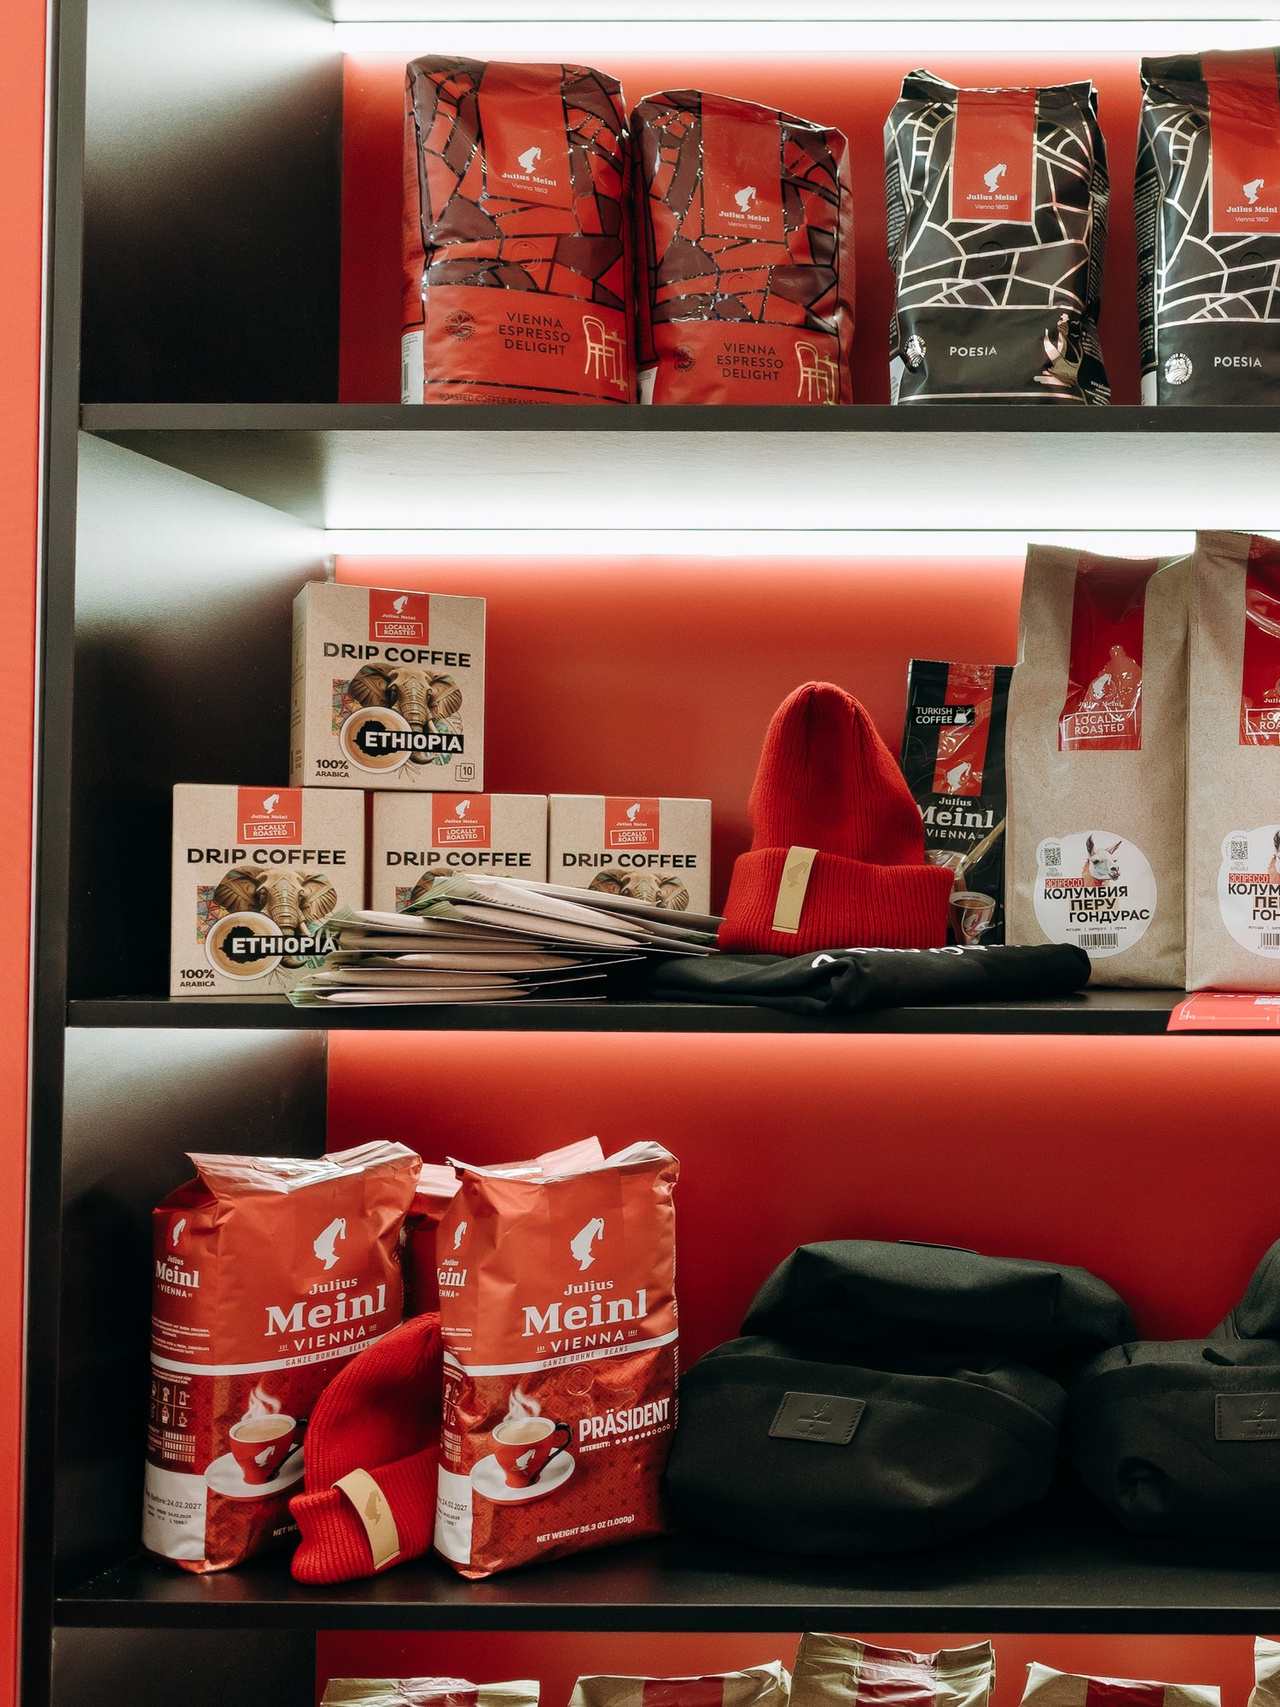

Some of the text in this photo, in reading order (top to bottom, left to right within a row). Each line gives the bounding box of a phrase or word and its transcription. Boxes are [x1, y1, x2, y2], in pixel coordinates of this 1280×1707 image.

[966, 193, 1018, 202] Julius Meinl
[1226, 205, 1278, 214] Julius Meinl
[506, 311, 564, 329] VIENNA
[498, 325, 571, 343] ESPRESSO
[504, 338, 566, 356] DELIGHT
[724, 343, 776, 356] VIENNA
[950, 345, 998, 357] POESIA
[717, 355, 784, 369] ESPRESSO
[1213, 356, 1262, 369] POESIA
[722, 368, 779, 382] DELIGHT
[438, 393, 474, 402] ROASTED
[323, 642, 471, 668] DRIP COFFEE
[916, 706, 953, 715] TURKISH
[915, 715, 953, 724] COFFEE
[1074, 723, 1125, 735] ROASTED
[364, 731, 463, 752] ETHIOPIA
[316, 759, 349, 770] 100%
[462, 766, 473, 776] 10
[315, 770, 350, 778] ARABICA
[938, 797, 972, 807] Julius
[916, 804, 994, 828] Meinl
[252, 829, 288, 837] ROASTED
[253, 824, 286, 832] LOCALLY
[446, 827, 477, 836] LOCALLY
[618, 830, 646, 838] LOCALLY
[926, 828, 976, 840] VIENNA
[445, 832, 478, 841] ROASTED
[617, 836, 648, 844] ROASTED
[187, 848, 346, 865] DRIP COFFEE
[386, 851, 532, 867] DRIP COFFEE
[562, 853, 697, 868] DRIP COFFEE
[1045, 878, 1083, 888] ЭСПРЕССО
[1229, 874, 1269, 883] ЭСПРЕССО
[1044, 886, 1128, 900] КОЛУМБИЯ
[1071, 898, 1116, 911] ПЕРУ
[1069, 909, 1150, 924] ГОНДУРАС
[232, 936, 337, 954] ETHIOPIA
[180, 969, 215, 979] 100%
[179, 980, 216, 988] ARABICA
[167, 1255, 184, 1266] Julius
[155, 1260, 200, 1288] Meinl
[160, 1284, 188, 1298] VIENNA
[308, 1278, 358, 1295] Julius
[563, 1280, 614, 1296] Julius
[264, 1284, 386, 1336] Meinl
[521, 1288, 649, 1337] Meinl
[294, 1325, 366, 1352] VIENNA
[550, 1329, 625, 1353] VIENNA
[286, 1341, 370, 1366] GANZE BOHNE BEANS
[542, 1345, 629, 1368] GANZE BOHNE BEANS
[579, 1397, 670, 1442] PRÄSIDENT
[579, 1441, 611, 1453] INTENSITY:
[167, 1499, 202, 1510] 24.02.2027
[273, 1527, 287, 1537] NET
[536, 1514, 635, 1543] NET WEIGHT 35.3 OZ (1.000g)
